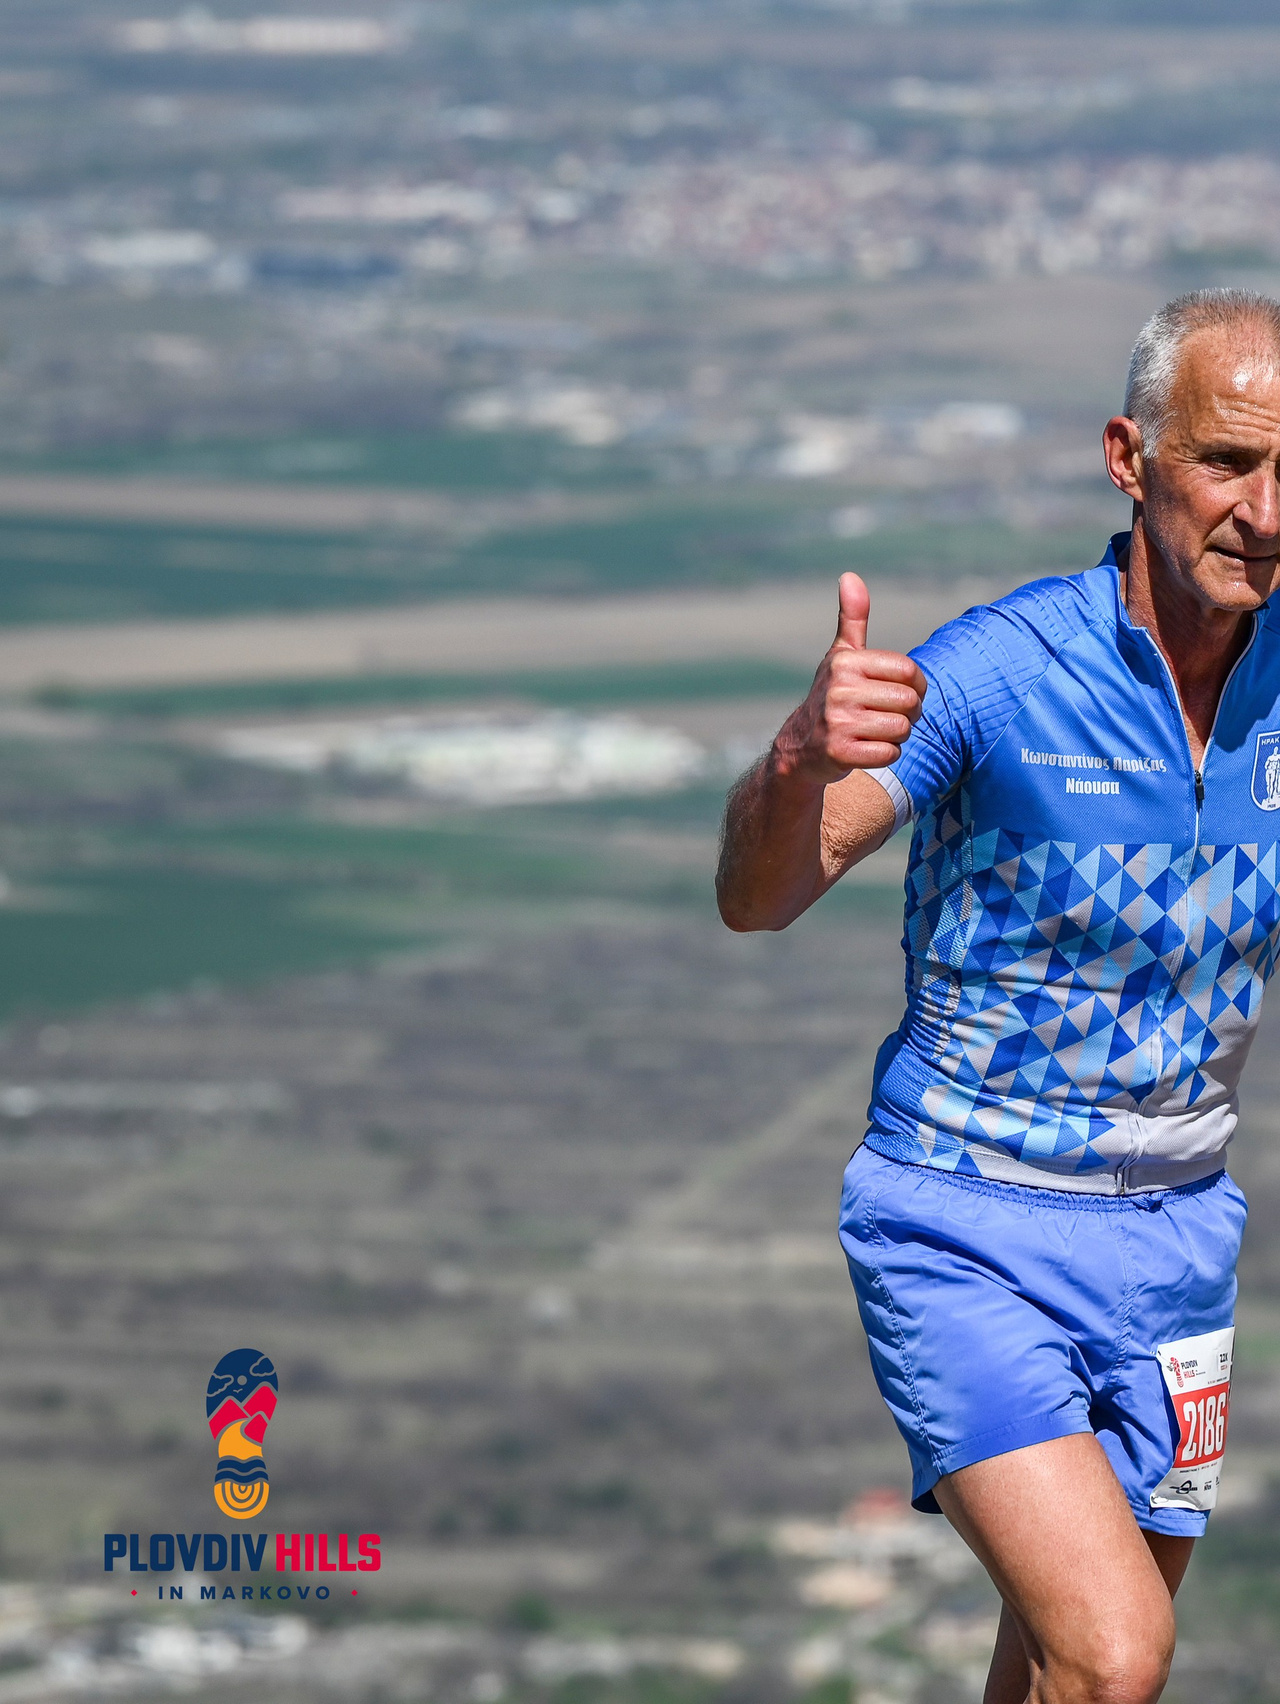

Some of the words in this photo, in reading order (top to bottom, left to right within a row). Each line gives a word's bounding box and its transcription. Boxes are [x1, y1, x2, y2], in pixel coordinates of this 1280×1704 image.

[1021, 748, 1109, 771] Κωνσταντίνος
[1066, 777, 1120, 795] Νάουσα
[1181, 1392, 1226, 1461] 2186
